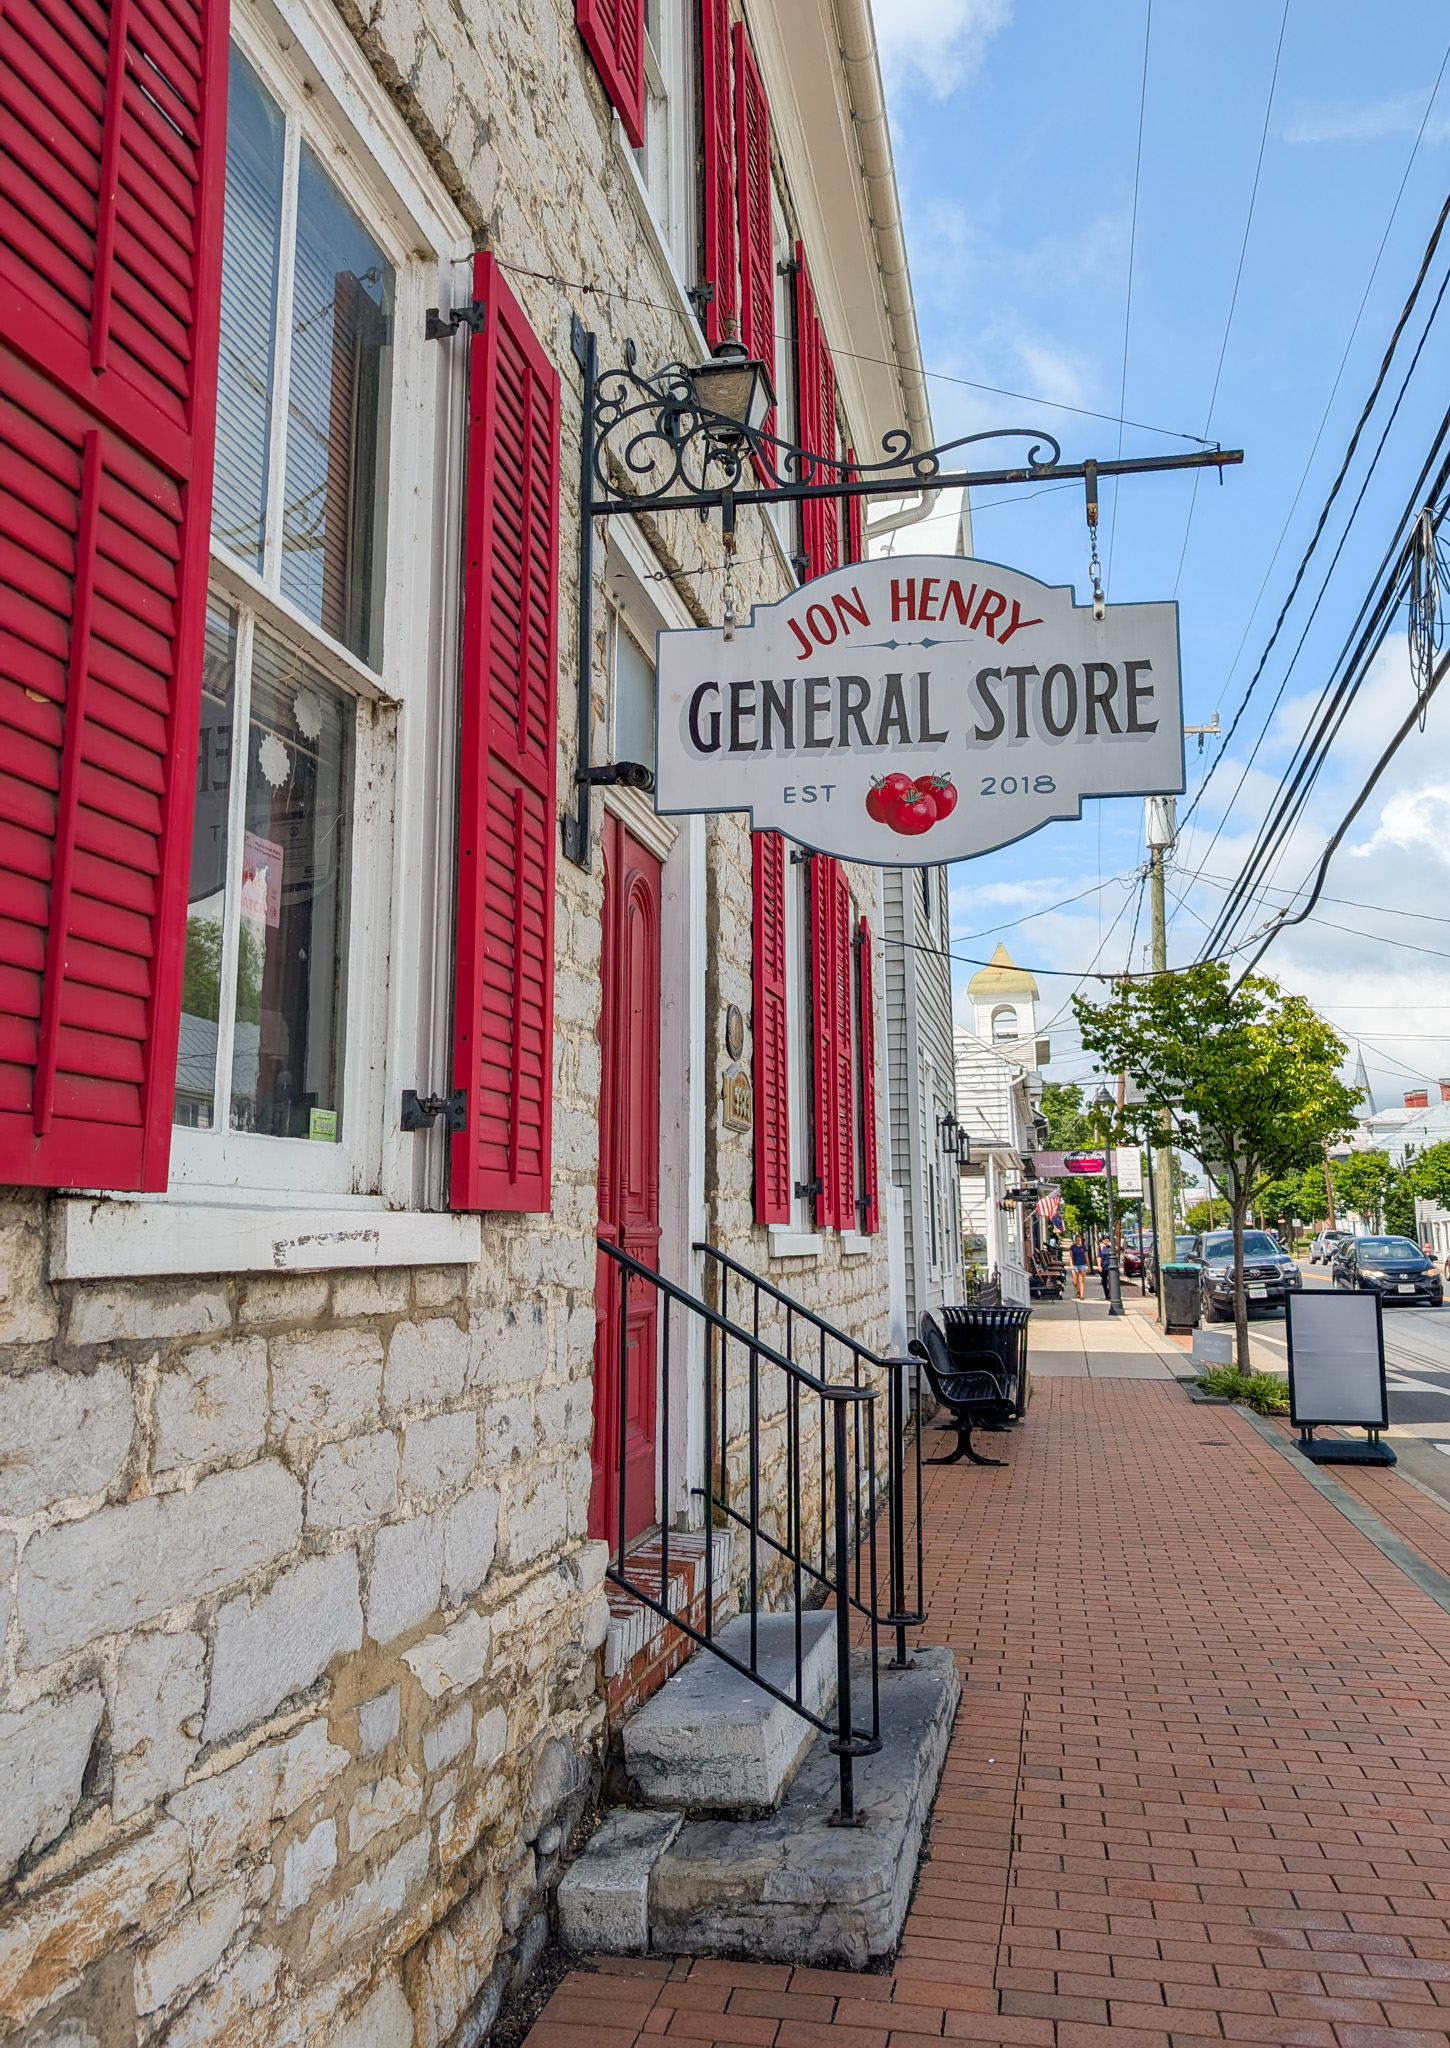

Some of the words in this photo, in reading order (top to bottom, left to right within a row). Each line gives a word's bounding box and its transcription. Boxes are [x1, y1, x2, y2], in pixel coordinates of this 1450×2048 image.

[786, 586, 871, 660] JON
[890, 577, 1044, 645] HENRY
[687, 671, 950, 754] GENERAL
[973, 659, 1160, 742] STORE
[783, 784, 837, 804] EST
[980, 774, 1057, 797] 2018
